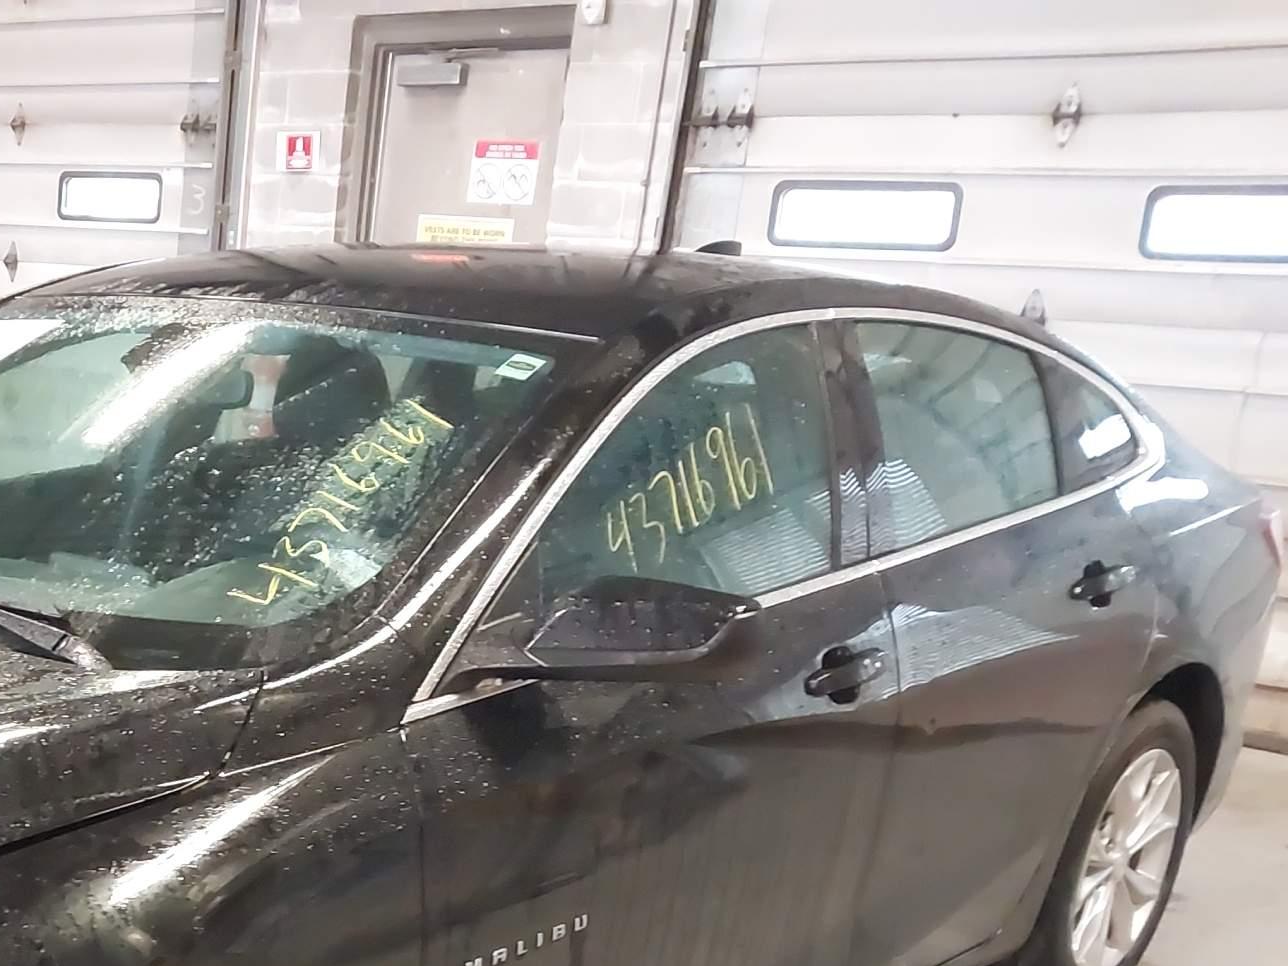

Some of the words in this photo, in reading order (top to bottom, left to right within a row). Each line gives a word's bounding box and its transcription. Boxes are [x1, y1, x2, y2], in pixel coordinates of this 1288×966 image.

[187, 183, 207, 215] 3
[447, 226, 459, 235] ARE
[462, 227, 472, 235] TO
[472, 228, 481, 236] BE
[225, 395, 455, 606] 43716961
[606, 402, 775, 574] 43716961
